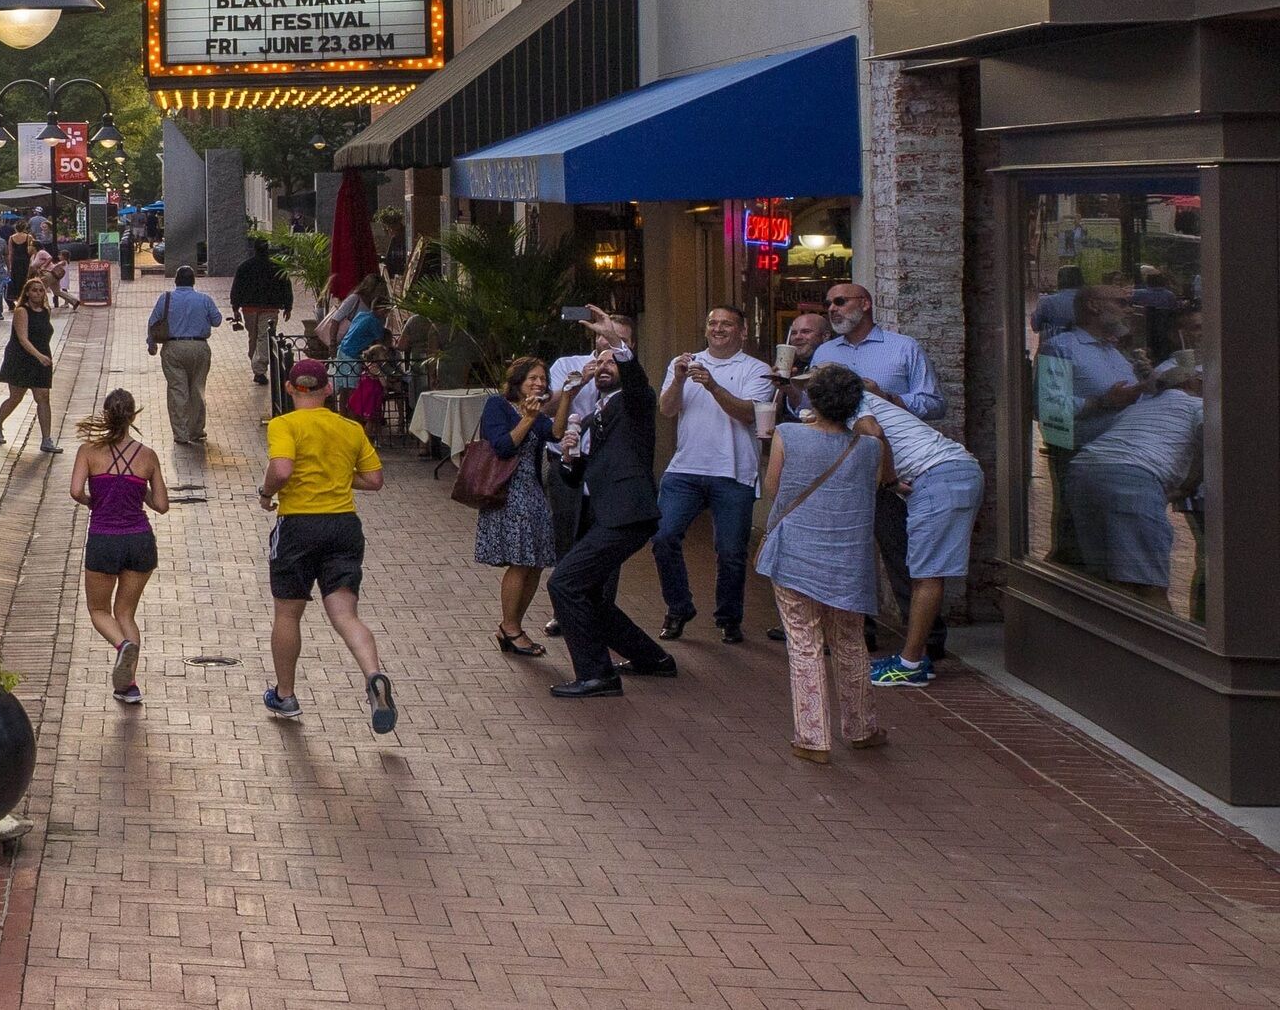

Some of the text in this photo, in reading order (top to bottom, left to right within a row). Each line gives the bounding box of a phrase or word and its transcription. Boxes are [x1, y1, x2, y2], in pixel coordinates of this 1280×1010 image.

[212, 11, 370, 31] FILM FESTIVAL
[259, 36, 314, 53] JUNE
[61, 157, 83, 172] 50
